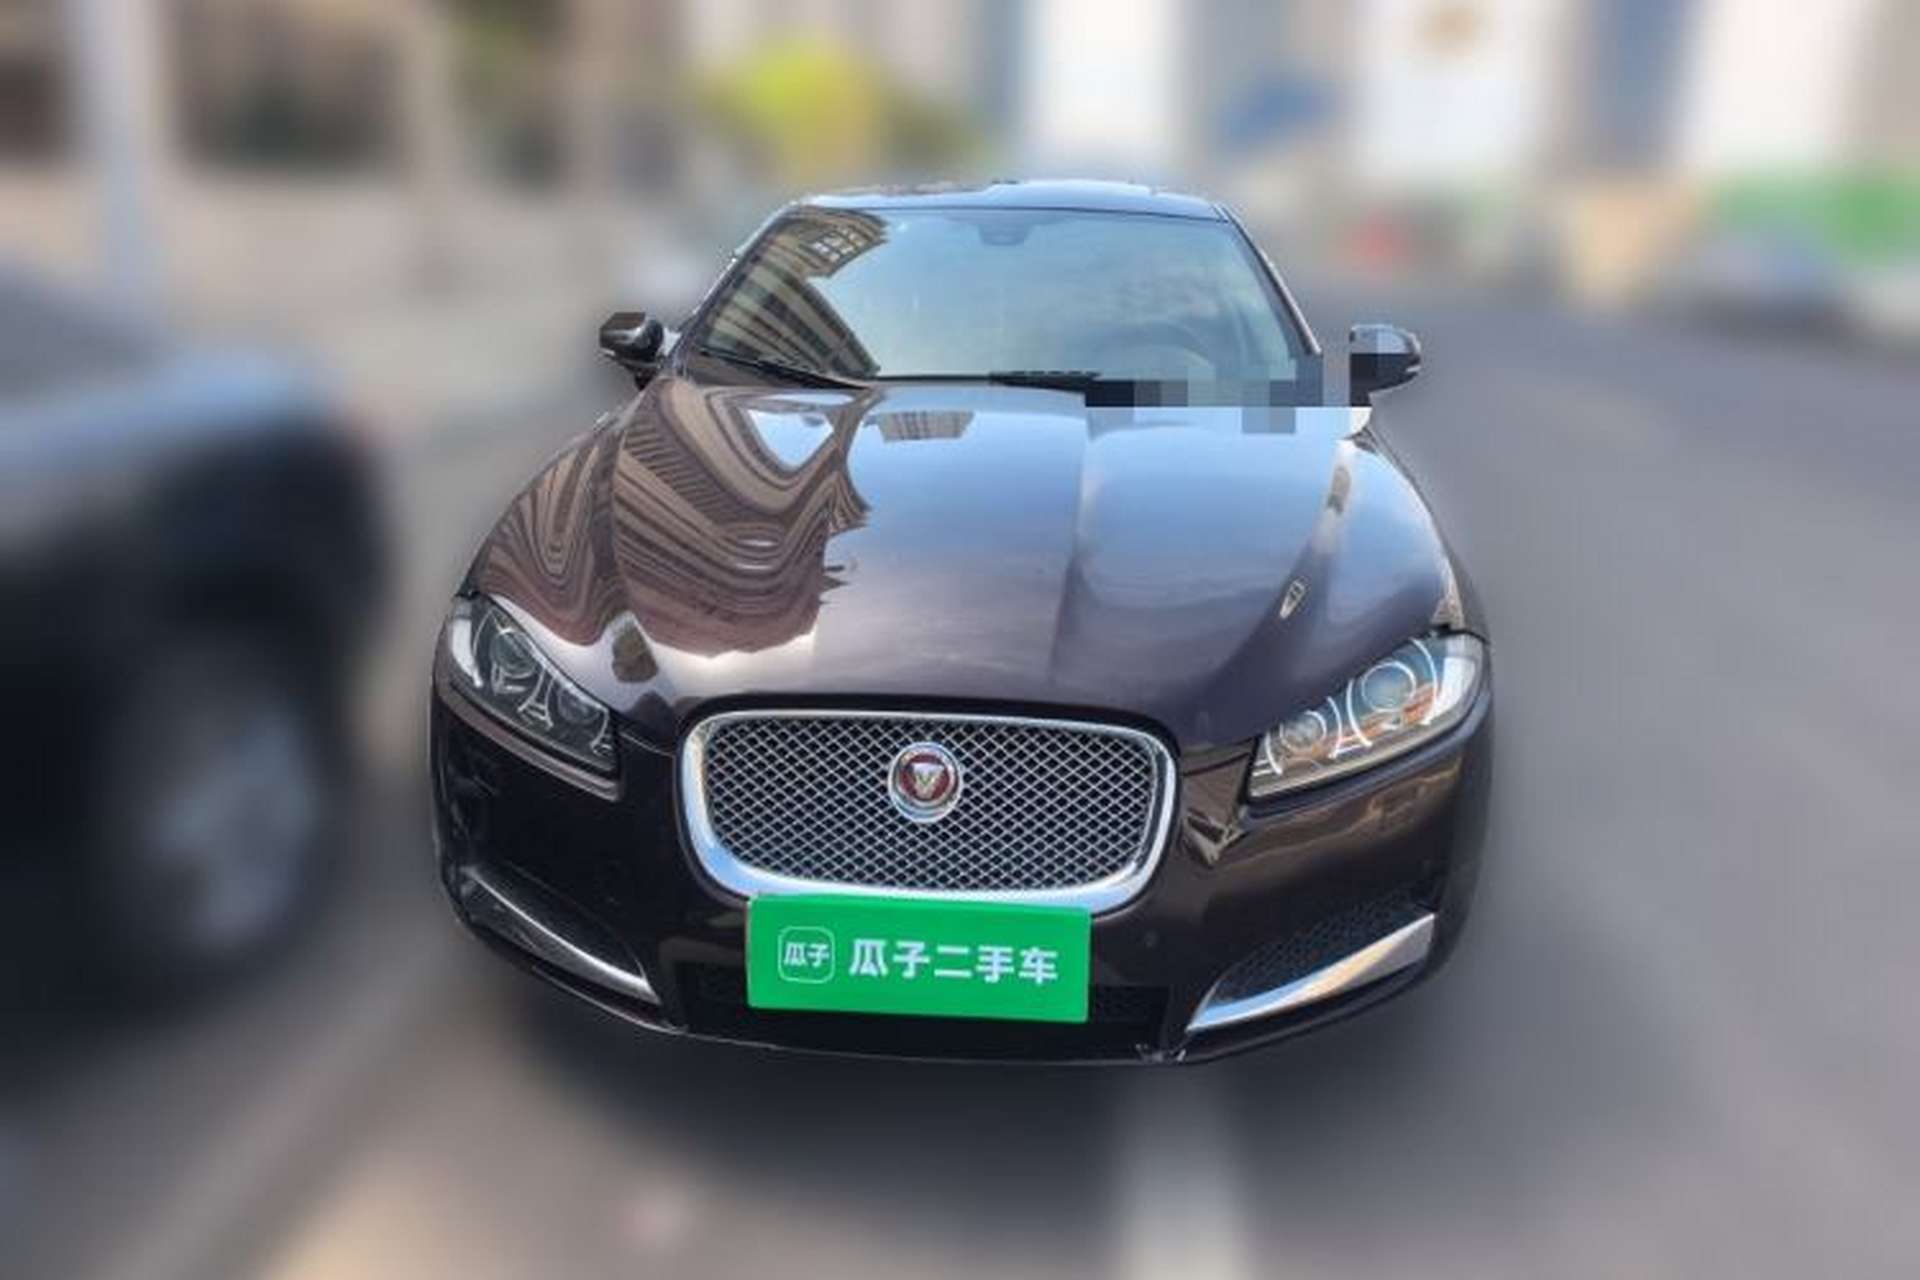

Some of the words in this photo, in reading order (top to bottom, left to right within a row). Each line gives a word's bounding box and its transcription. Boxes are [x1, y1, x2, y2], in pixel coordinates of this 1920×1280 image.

[783, 941, 830, 968] 瓜子
[850, 938, 1058, 985] 瓜子二手车
